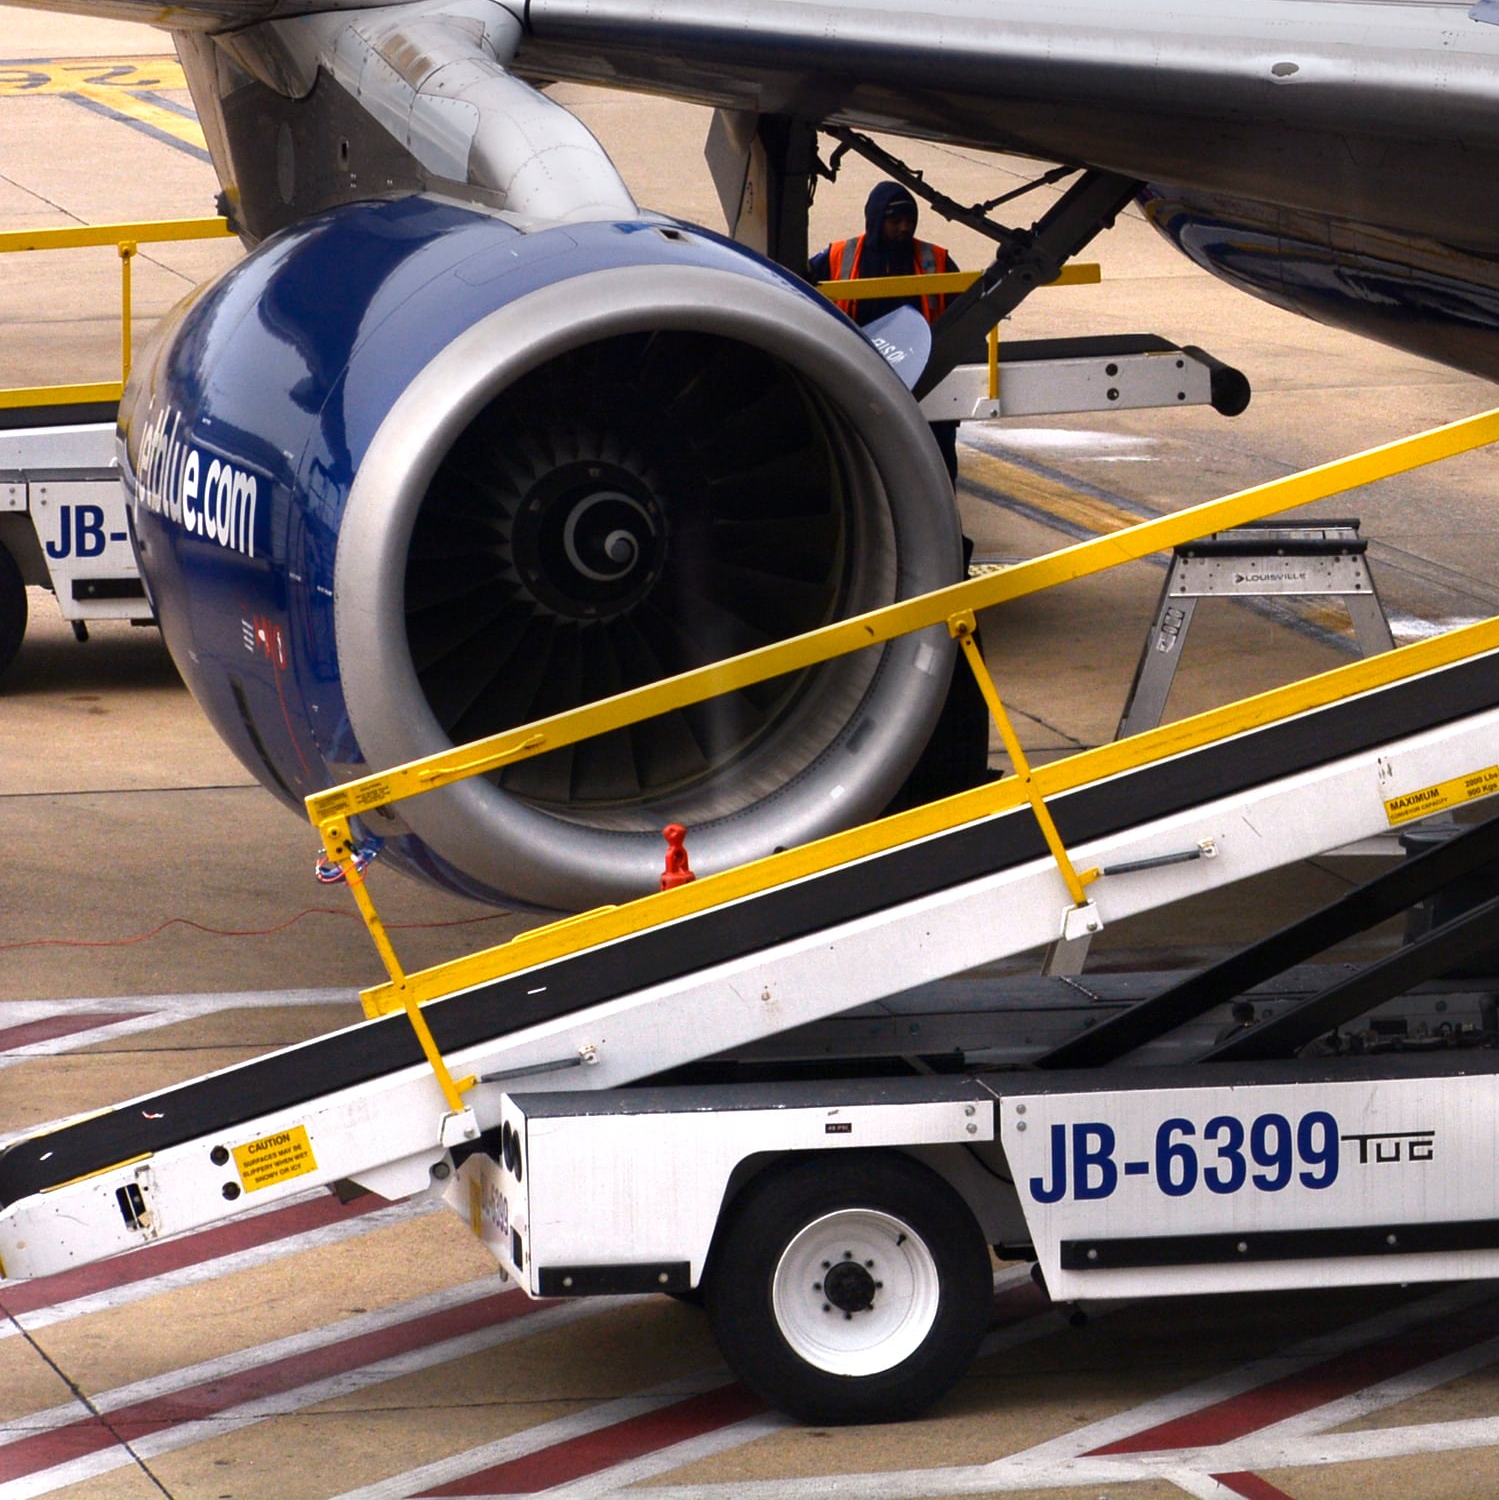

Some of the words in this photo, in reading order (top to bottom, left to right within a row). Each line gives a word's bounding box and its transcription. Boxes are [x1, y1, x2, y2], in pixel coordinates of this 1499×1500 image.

[1245, 572, 1306, 582] LOUISVILLE
[1464, 776, 1483, 788] 2000
[1390, 788, 1440, 811] MAXIMUM
[248, 1133, 290, 1154] CAUTION
[242, 1164, 273, 1178] SLIPPERY
[274, 1157, 294, 1167] WHEN
[294, 1151, 308, 1161] WET
[243, 1152, 277, 1168] SURFACES
[278, 1147, 292, 1156] MAY
[292, 1143, 302, 1151] BE
[1029, 1111, 1340, 1204] JB-6399
[255, 1171, 278, 1183] SNOWY
[291, 1163, 301, 1171] ICY
